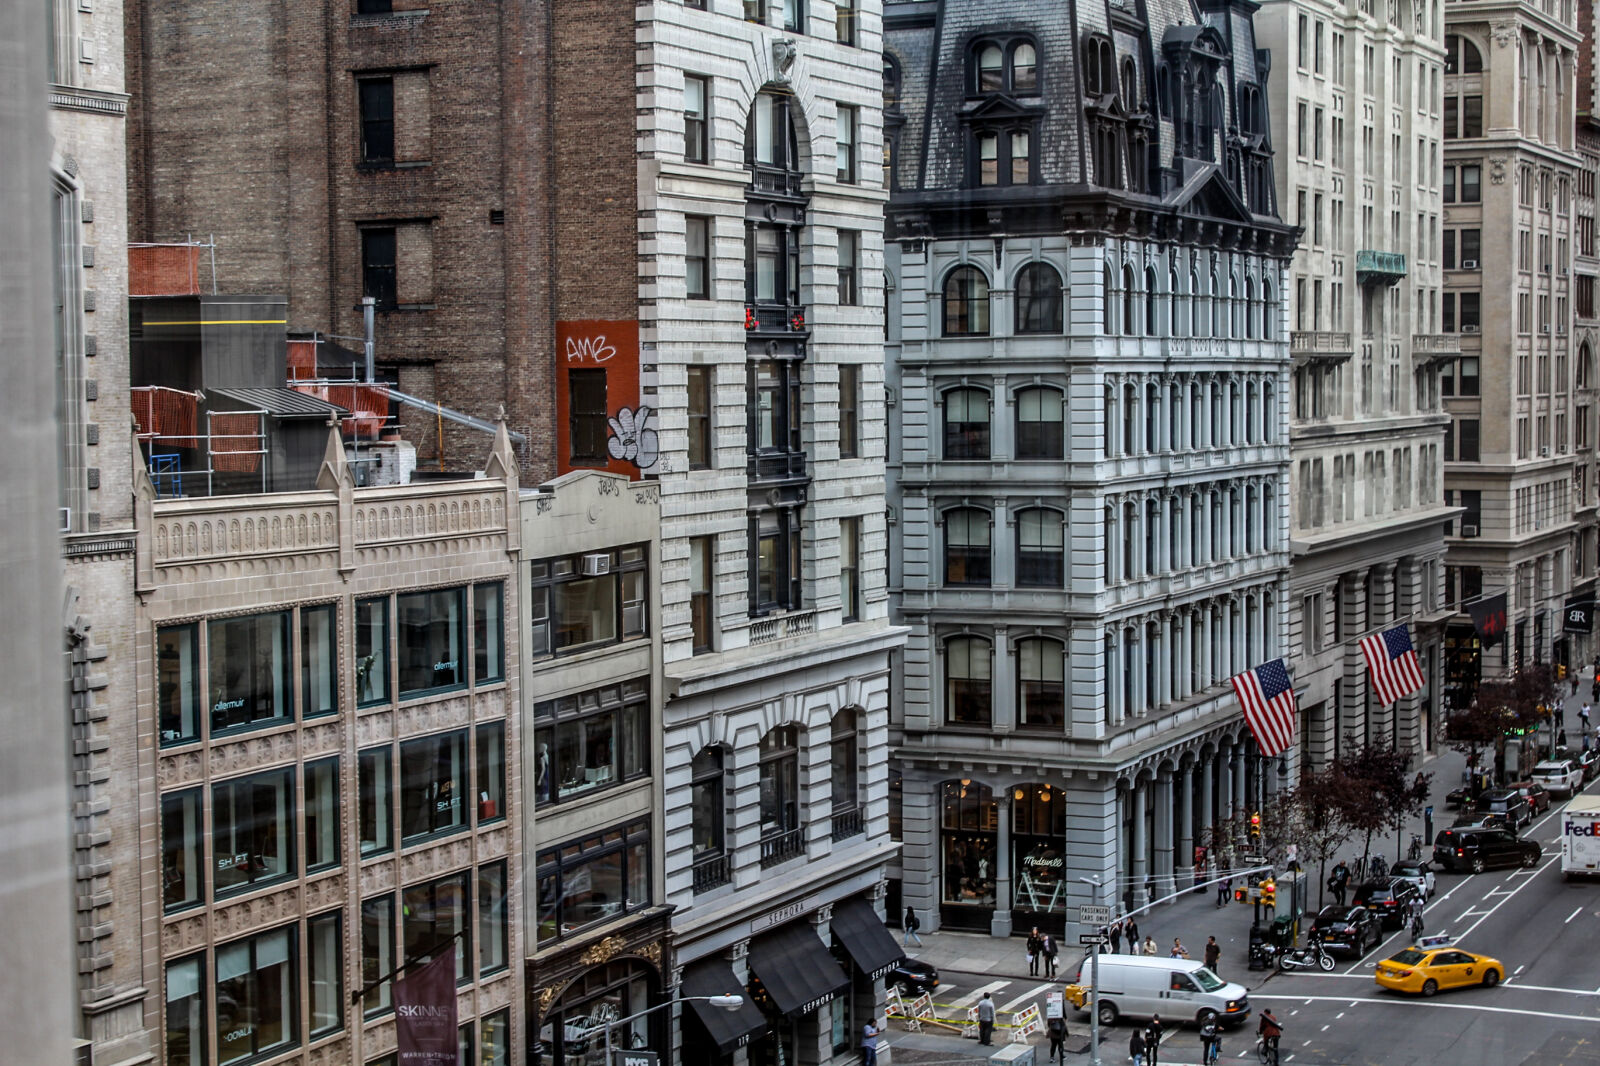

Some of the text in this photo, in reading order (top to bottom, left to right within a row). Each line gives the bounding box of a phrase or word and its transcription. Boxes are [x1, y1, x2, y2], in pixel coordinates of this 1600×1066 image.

[1024, 856, 1063, 867] Madewell
[769, 903, 804, 926] SEPHORA
[872, 960, 900, 981] SEPHORA
[803, 992, 834, 1014] SEPHORA
